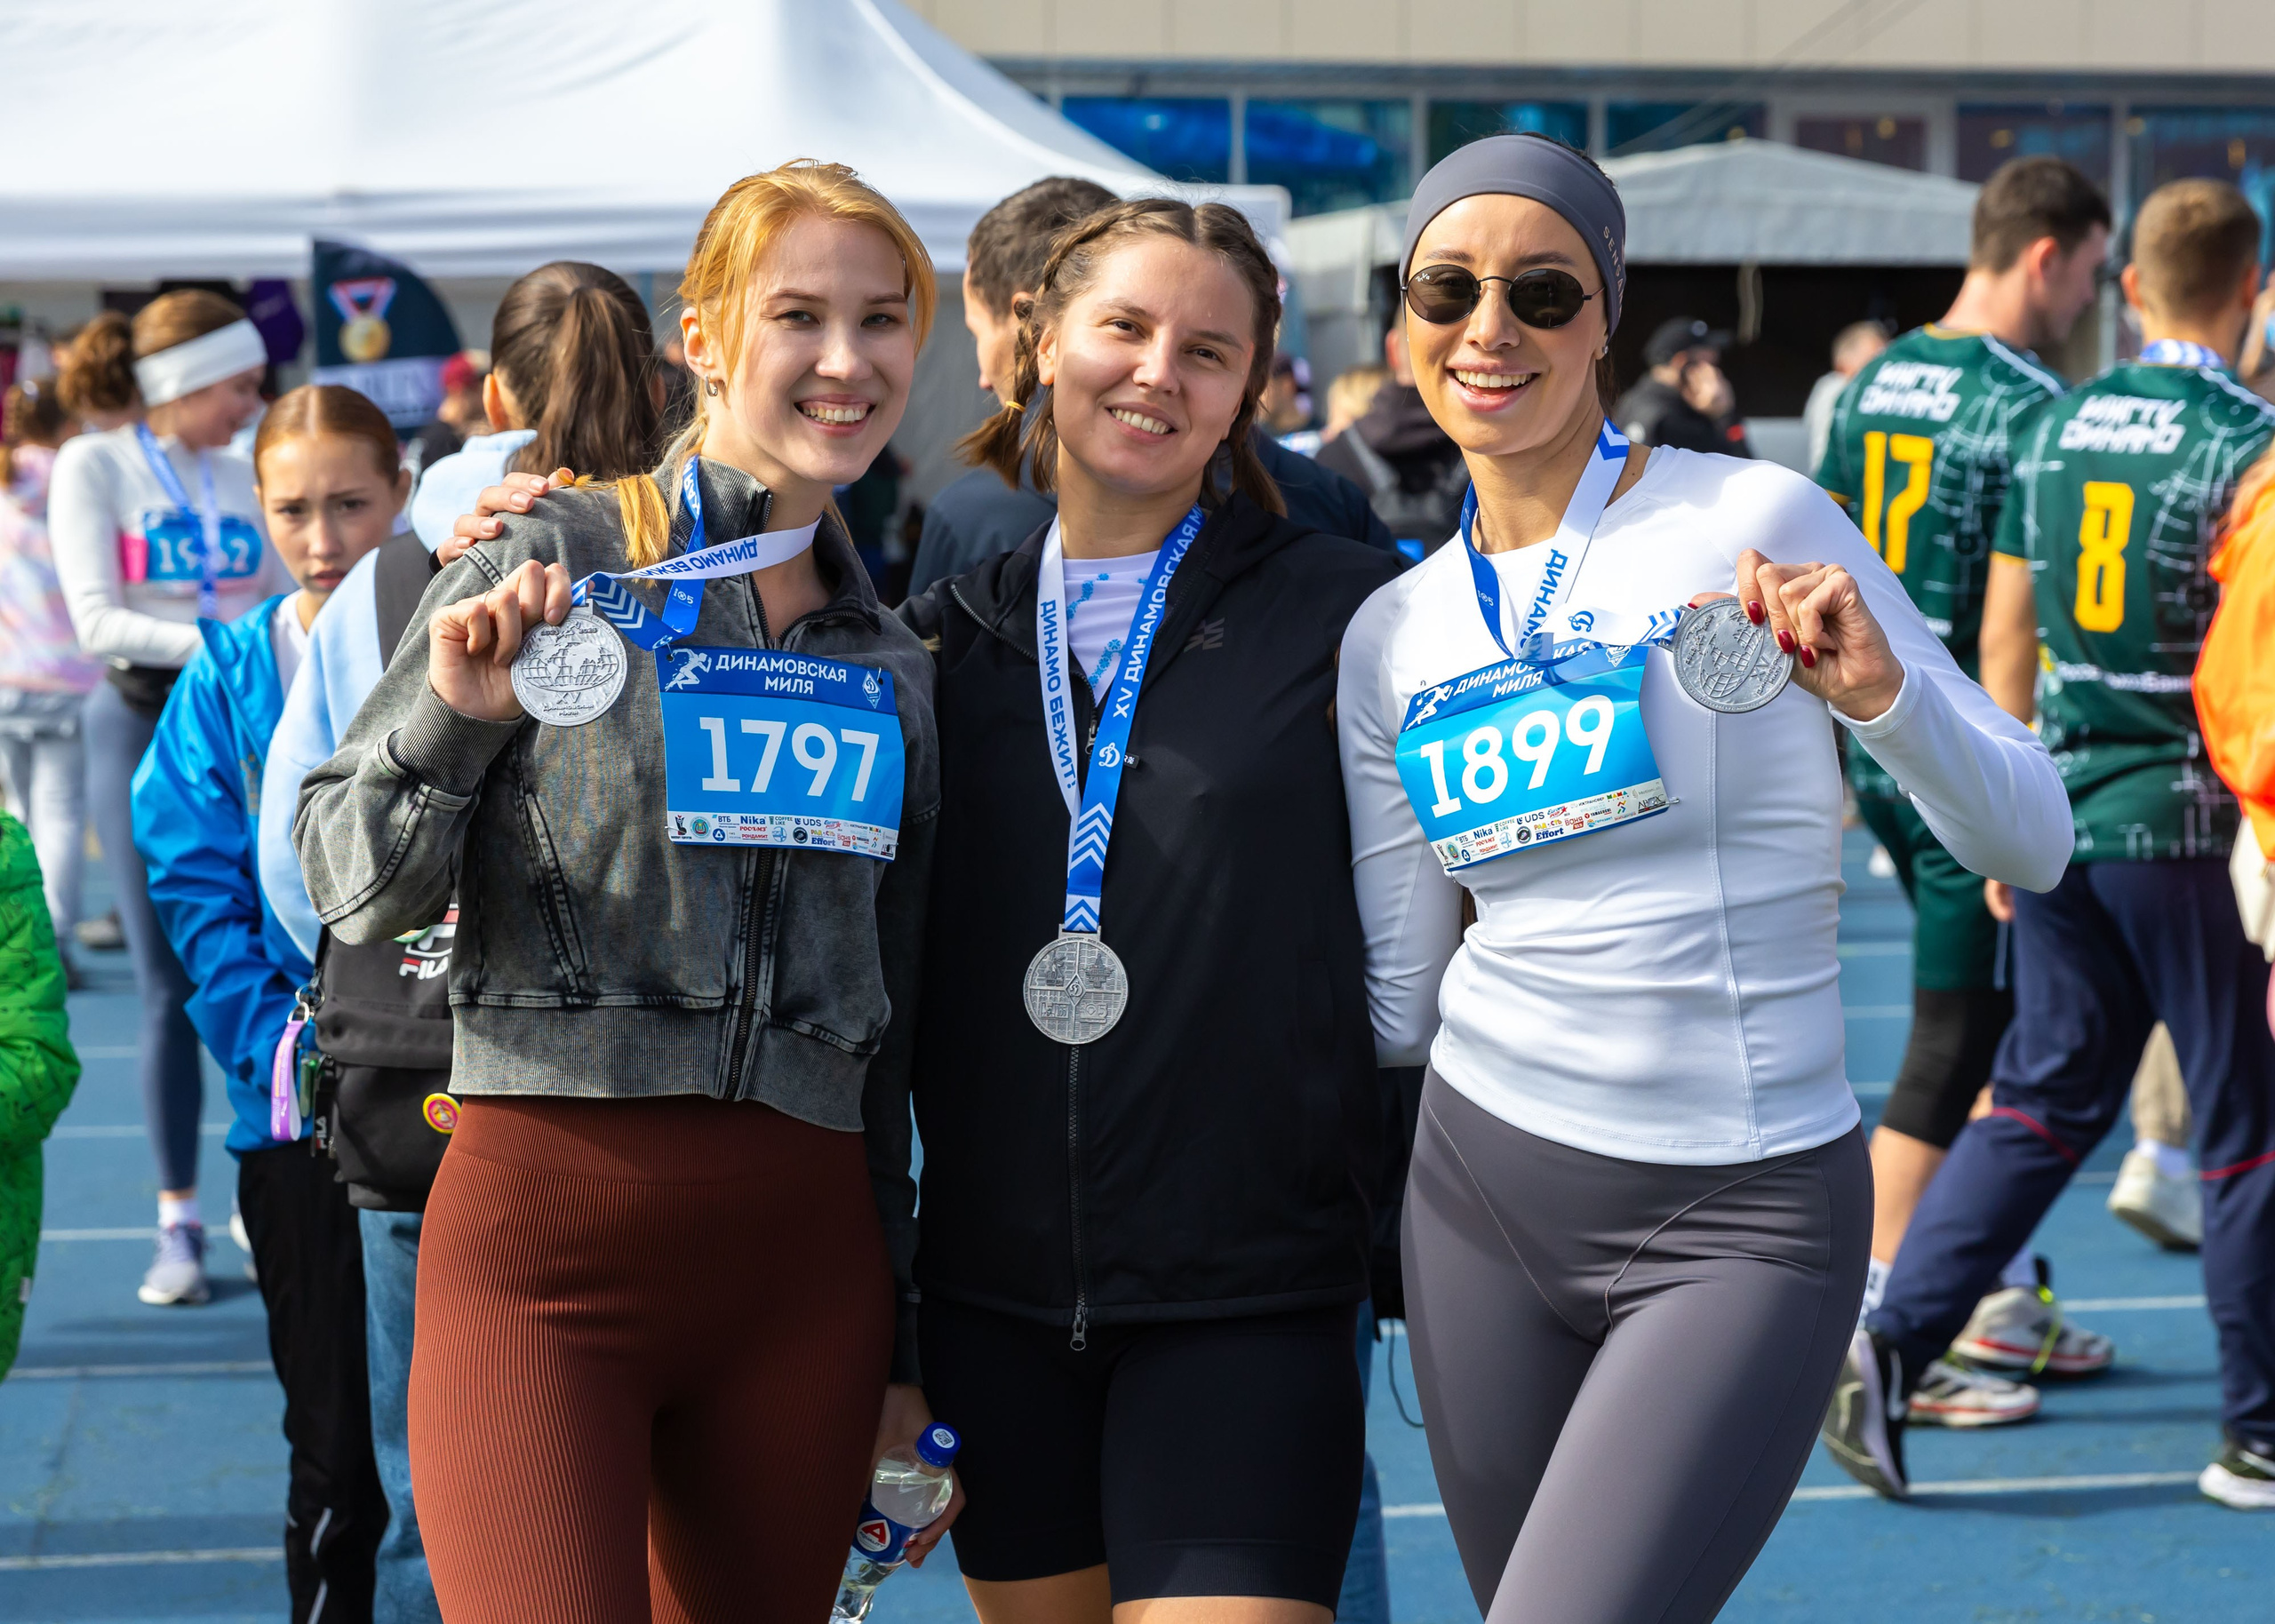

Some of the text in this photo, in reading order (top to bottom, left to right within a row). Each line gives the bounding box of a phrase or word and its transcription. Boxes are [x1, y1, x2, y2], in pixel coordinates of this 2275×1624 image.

[1864, 432, 1934, 575] 17
[691, 537, 759, 576] ДИНАМО
[2074, 481, 2135, 633] 8
[1113, 687, 1133, 719] XV
[1124, 523, 1198, 683] ДИНАМОВСКАЯ
[715, 654, 848, 683] ДИНАМОВСКАЯ
[1452, 641, 1591, 696] ДИНАМОКАЯ
[764, 675, 814, 695] МИЛЯ
[1041, 600, 1076, 789] ДИНАМО БЕЖИТ!
[1492, 668, 1545, 699] МИЛЯ
[699, 716, 880, 803] 1797
[1420, 694, 1616, 819] 1899
[717, 815, 731, 824] ВТБ
[740, 815, 766, 825] Nika
[802, 818, 822, 827] UDS
[1524, 811, 1545, 824] UDS
[810, 837, 836, 847] Effort
[1458, 834, 1469, 844] ВТБ
[1473, 827, 1494, 840] Nika
[1535, 827, 1565, 841] Effort
[400, 957, 450, 981] FILA
[315, 1116, 328, 1150] FILA
